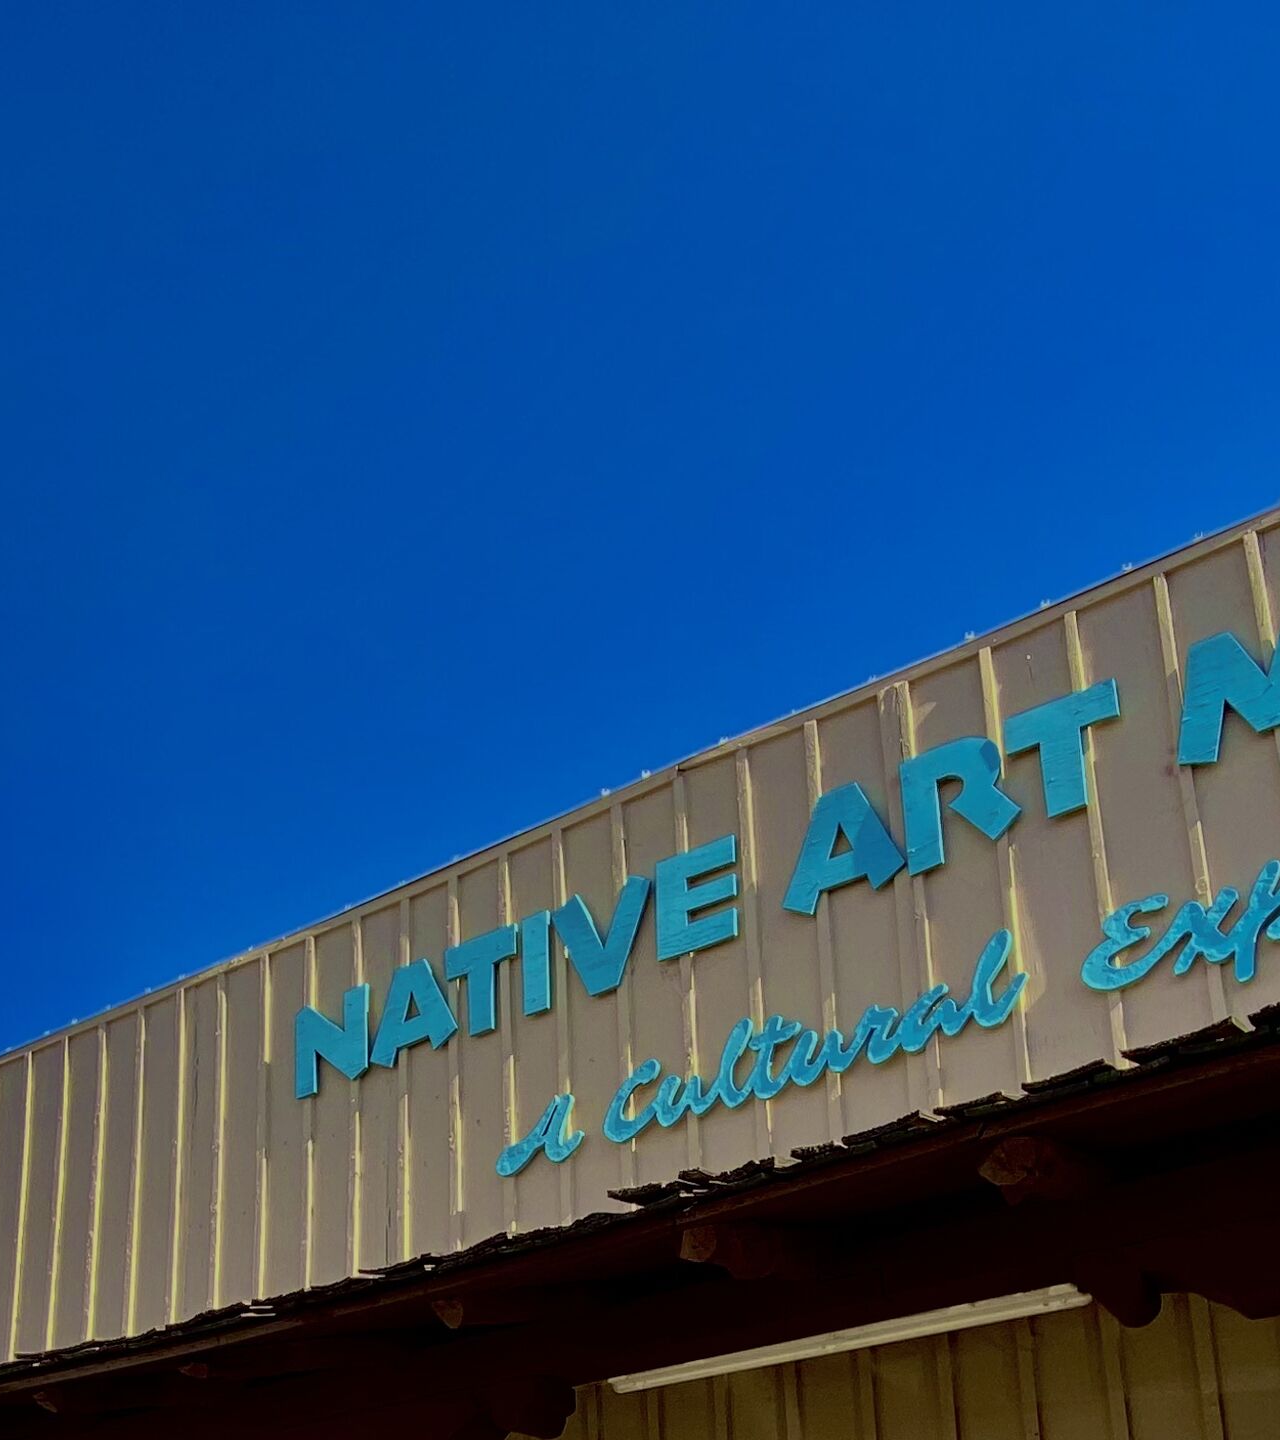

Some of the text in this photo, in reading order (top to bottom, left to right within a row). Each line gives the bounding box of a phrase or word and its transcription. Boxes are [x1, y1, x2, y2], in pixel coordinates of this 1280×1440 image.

[295, 835, 738, 1099] NATIVE
[783, 678, 1120, 915] ART
[496, 1094, 585, 1177] A
[602, 929, 1029, 1143] Cultural
